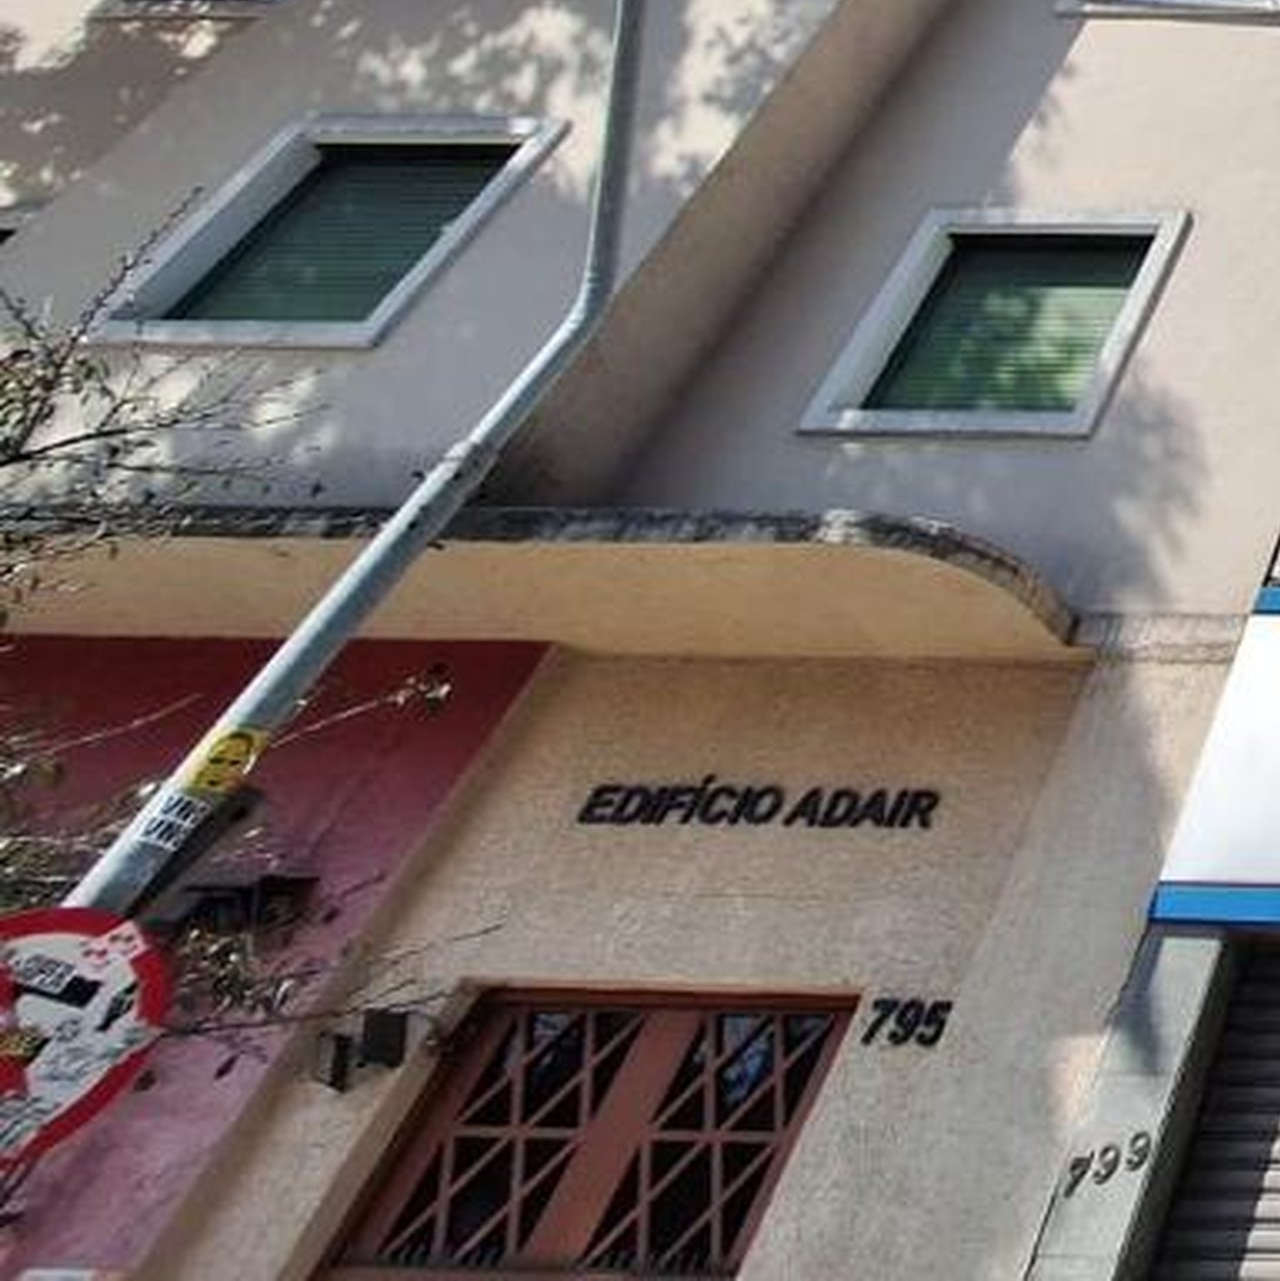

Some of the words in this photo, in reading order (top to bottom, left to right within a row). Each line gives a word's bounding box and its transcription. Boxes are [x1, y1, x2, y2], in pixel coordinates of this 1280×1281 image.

[578, 774, 786, 824] EDIFÍCIO
[783, 787, 940, 829] ADAIR
[861, 999, 953, 1047] 795
[1064, 1130, 1151, 1199] 799
